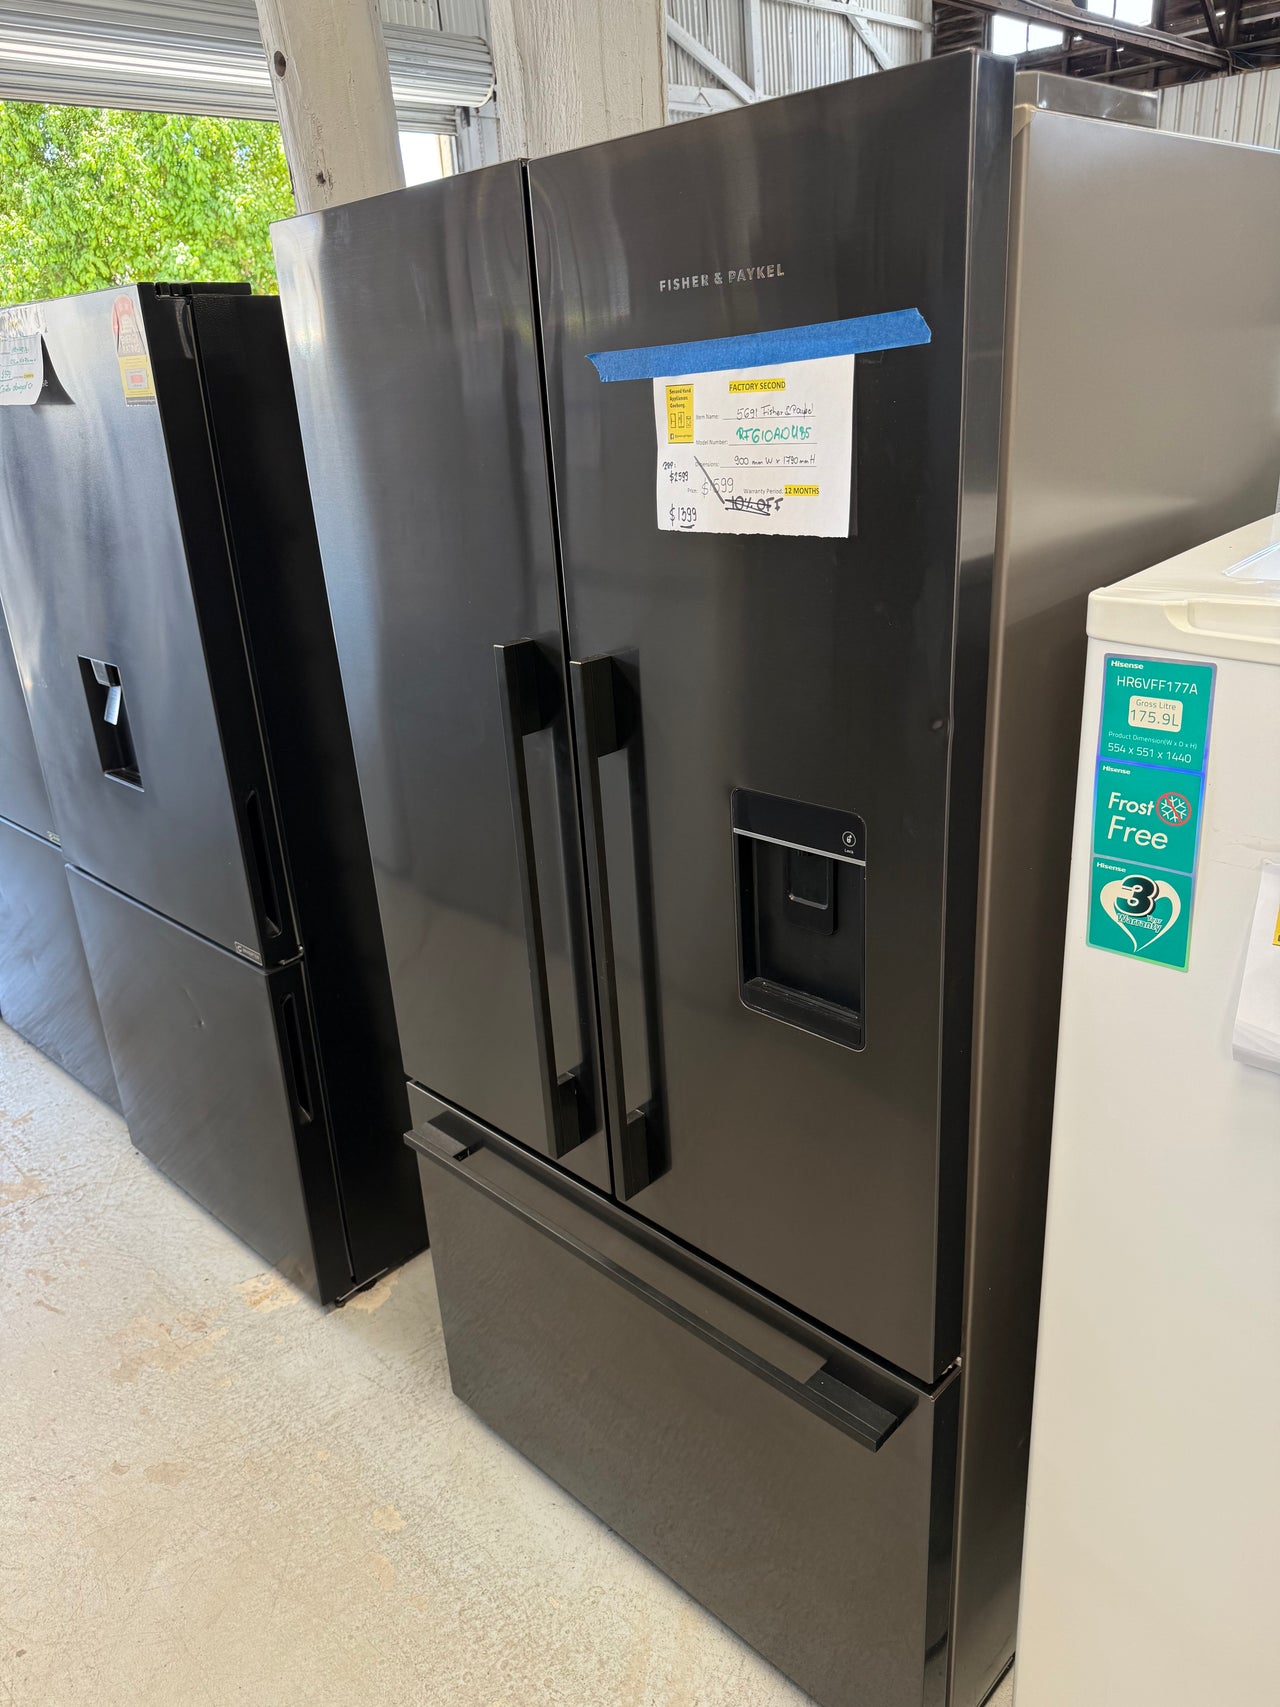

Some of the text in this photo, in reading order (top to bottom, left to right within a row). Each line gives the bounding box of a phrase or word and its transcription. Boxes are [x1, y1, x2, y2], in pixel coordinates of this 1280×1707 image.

[659, 263, 785, 292] FISHER & PAYKEL
[729, 381, 786, 392] FACTORY SECOND
[1110, 660, 1144, 670] Hisense
[1116, 676, 1198, 695] HR6VFF177A
[1136, 699, 1176, 710] Gross Litre
[1130, 710, 1179, 726] 175.9L
[1108, 731, 1131, 740] Product
[1108, 742, 1126, 753] 554
[1128, 747, 1134, 755] x
[1136, 746, 1154, 758] 551
[1166, 751, 1192, 764] 1440
[1102, 765, 1130, 775] Hisense
[1108, 792, 1154, 816] Frost
[1107, 815, 1168, 850] Free
[1096, 862, 1126, 873] Hisense
[1114, 874, 1159, 918] 3
